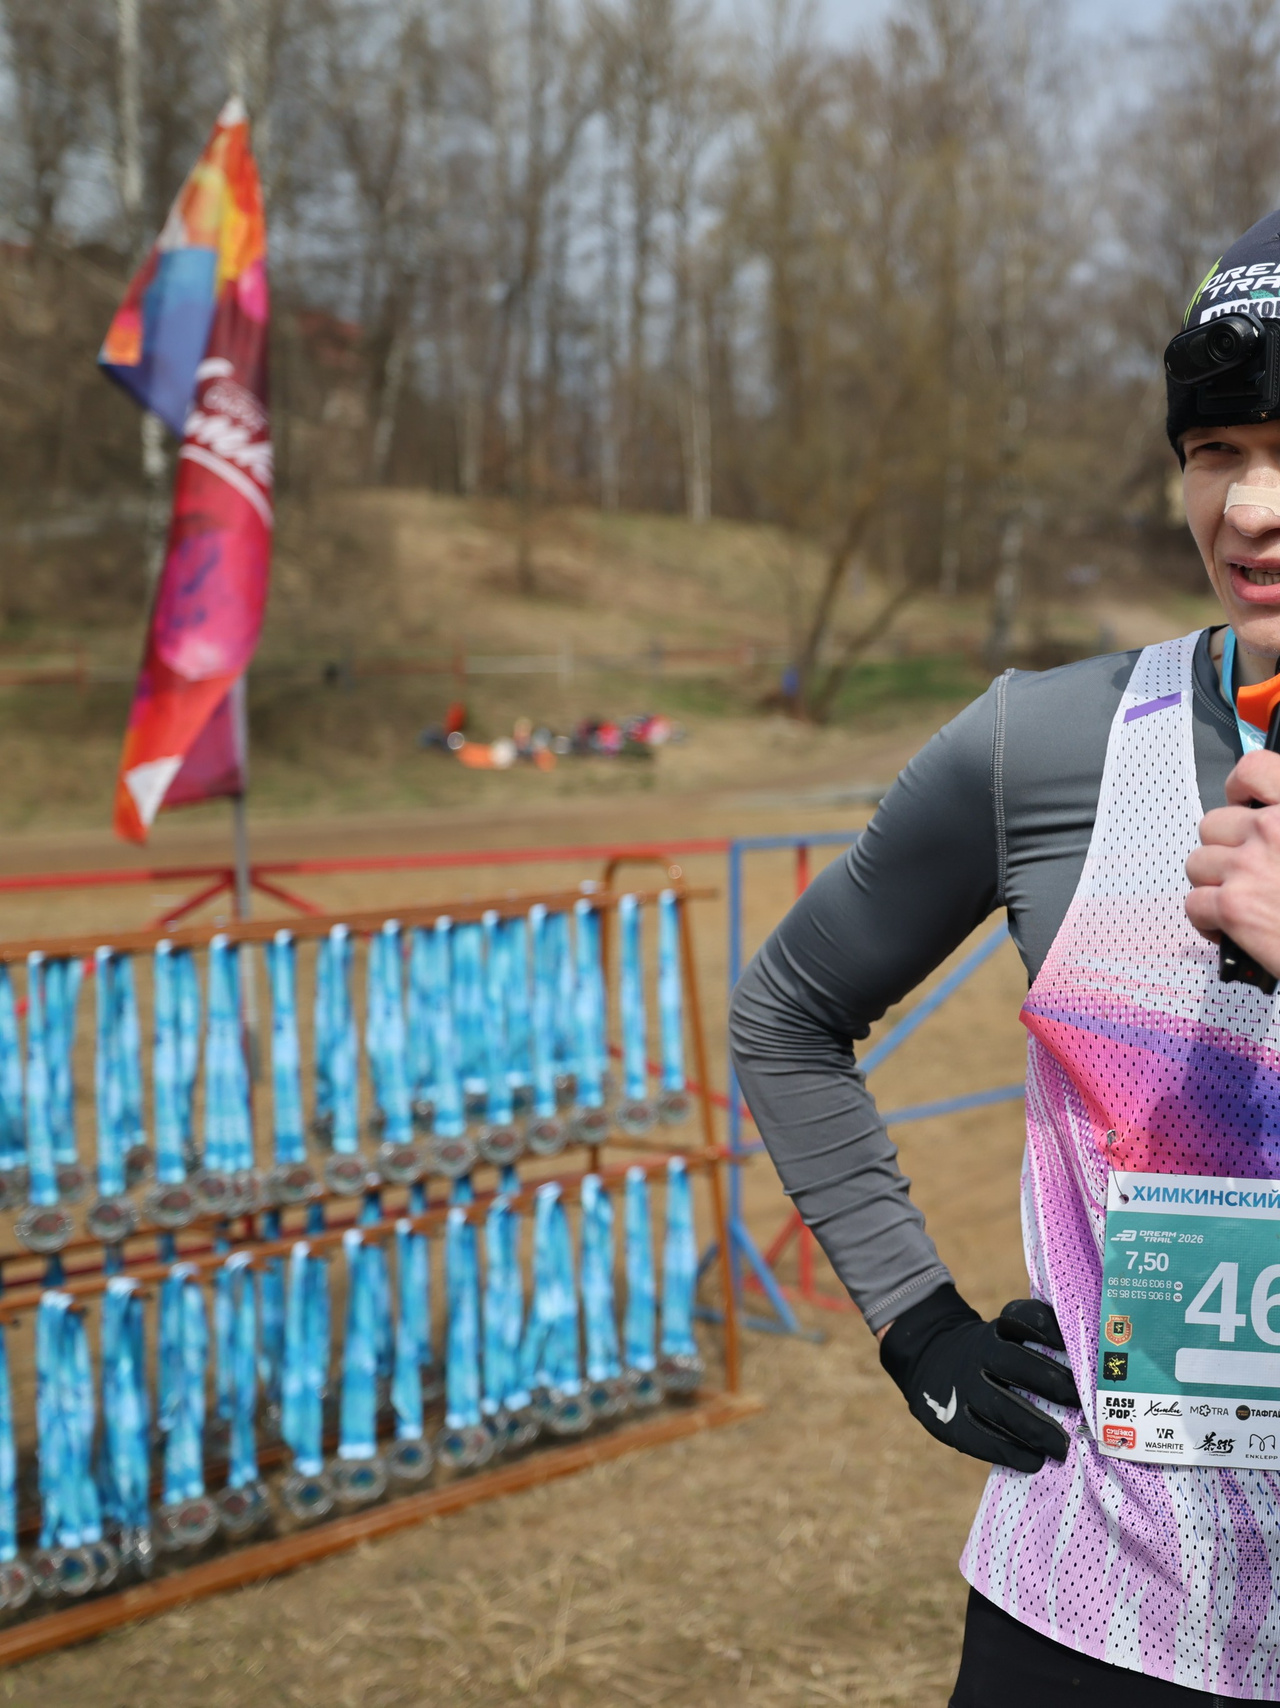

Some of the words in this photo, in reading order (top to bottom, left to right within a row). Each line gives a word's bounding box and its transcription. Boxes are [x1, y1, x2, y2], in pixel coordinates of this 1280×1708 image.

[1139, 1230, 1177, 1238] DREAM
[1177, 1234, 1204, 1244] 2026
[1143, 1236, 1172, 1244] TRAIL
[1125, 1251, 1170, 1274] 7,50
[1108, 1276, 1119, 1286] 99
[1120, 1277, 1131, 1286] 36
[1132, 1278, 1148, 1288] 978
[1149, 1279, 1165, 1288] 903
[1166, 1280, 1172, 1289] 8
[1107, 1288, 1118, 1298] 53
[1119, 1289, 1130, 1298] 85
[1131, 1290, 1147, 1300] 513
[1148, 1291, 1164, 1300] 905
[1165, 1292, 1171, 1301] 8
[1105, 1397, 1135, 1408] EASY
[1109, 1409, 1131, 1419] POP
[1145, 1441, 1184, 1450] WASHRITE
